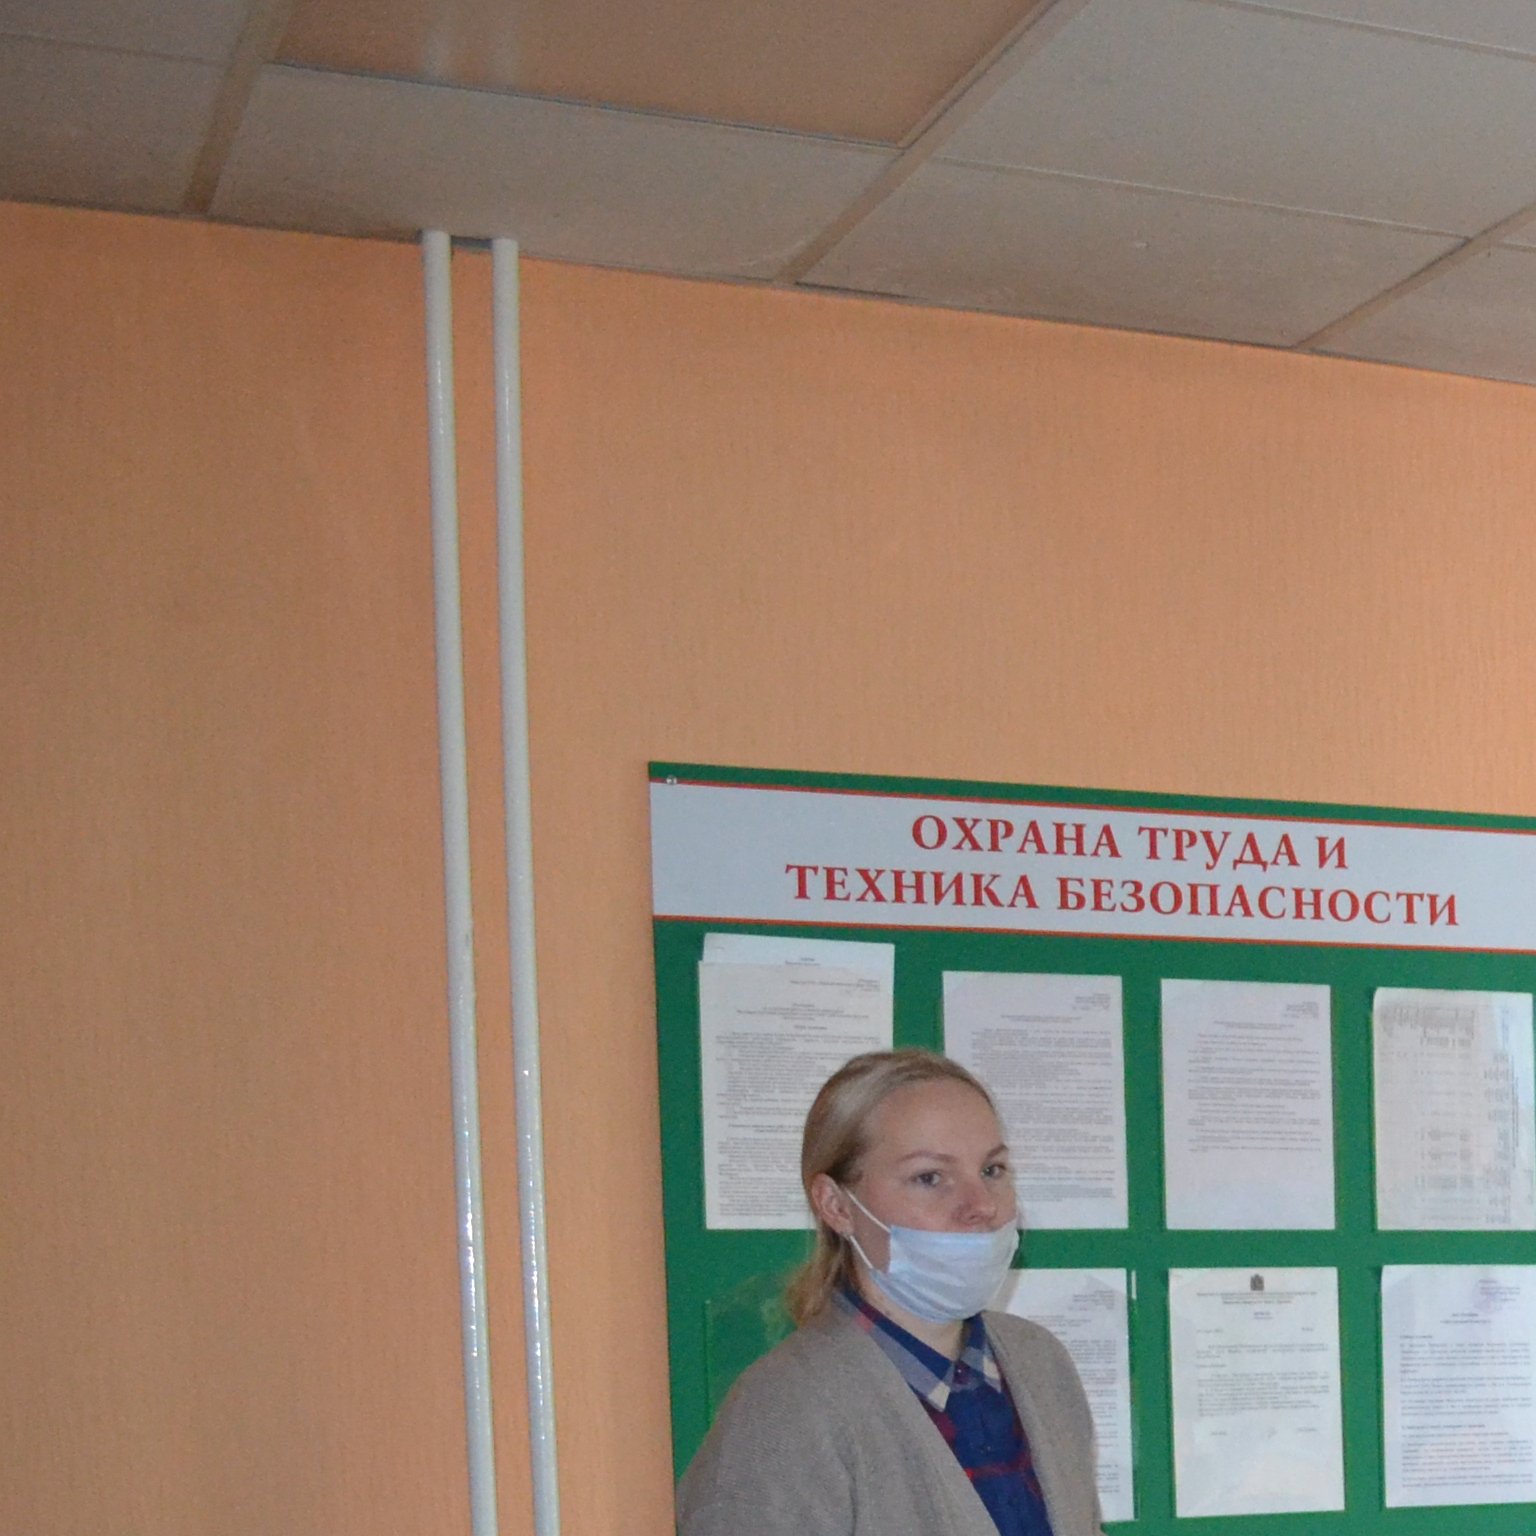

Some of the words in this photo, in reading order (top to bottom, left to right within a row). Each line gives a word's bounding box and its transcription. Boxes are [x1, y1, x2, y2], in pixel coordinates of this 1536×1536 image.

[911, 814, 1122, 859] ОХРАНА
[1138, 825, 1300, 872] ТРУДА
[1315, 835, 1349, 869] И
[785, 863, 1040, 909] ТЕХНИКА
[1056, 876, 1460, 926] БЕЗОПАСНОСТИ
